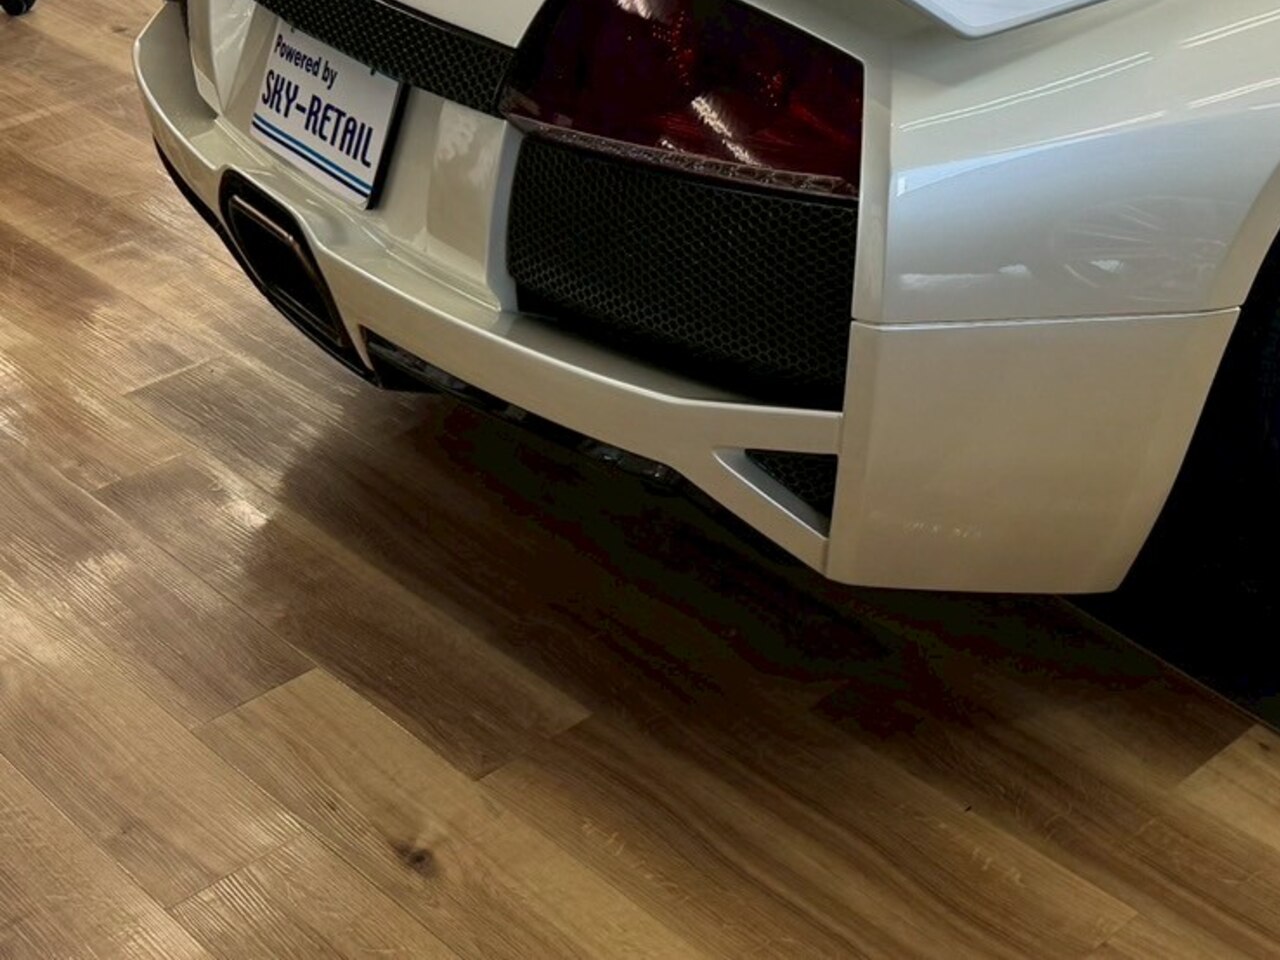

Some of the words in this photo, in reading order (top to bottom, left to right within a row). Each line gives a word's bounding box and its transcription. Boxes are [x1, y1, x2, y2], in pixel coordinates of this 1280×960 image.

[274, 34, 322, 77] Powered
[321, 60, 339, 90] by
[261, 69, 374, 169] SKY-RETAIL
